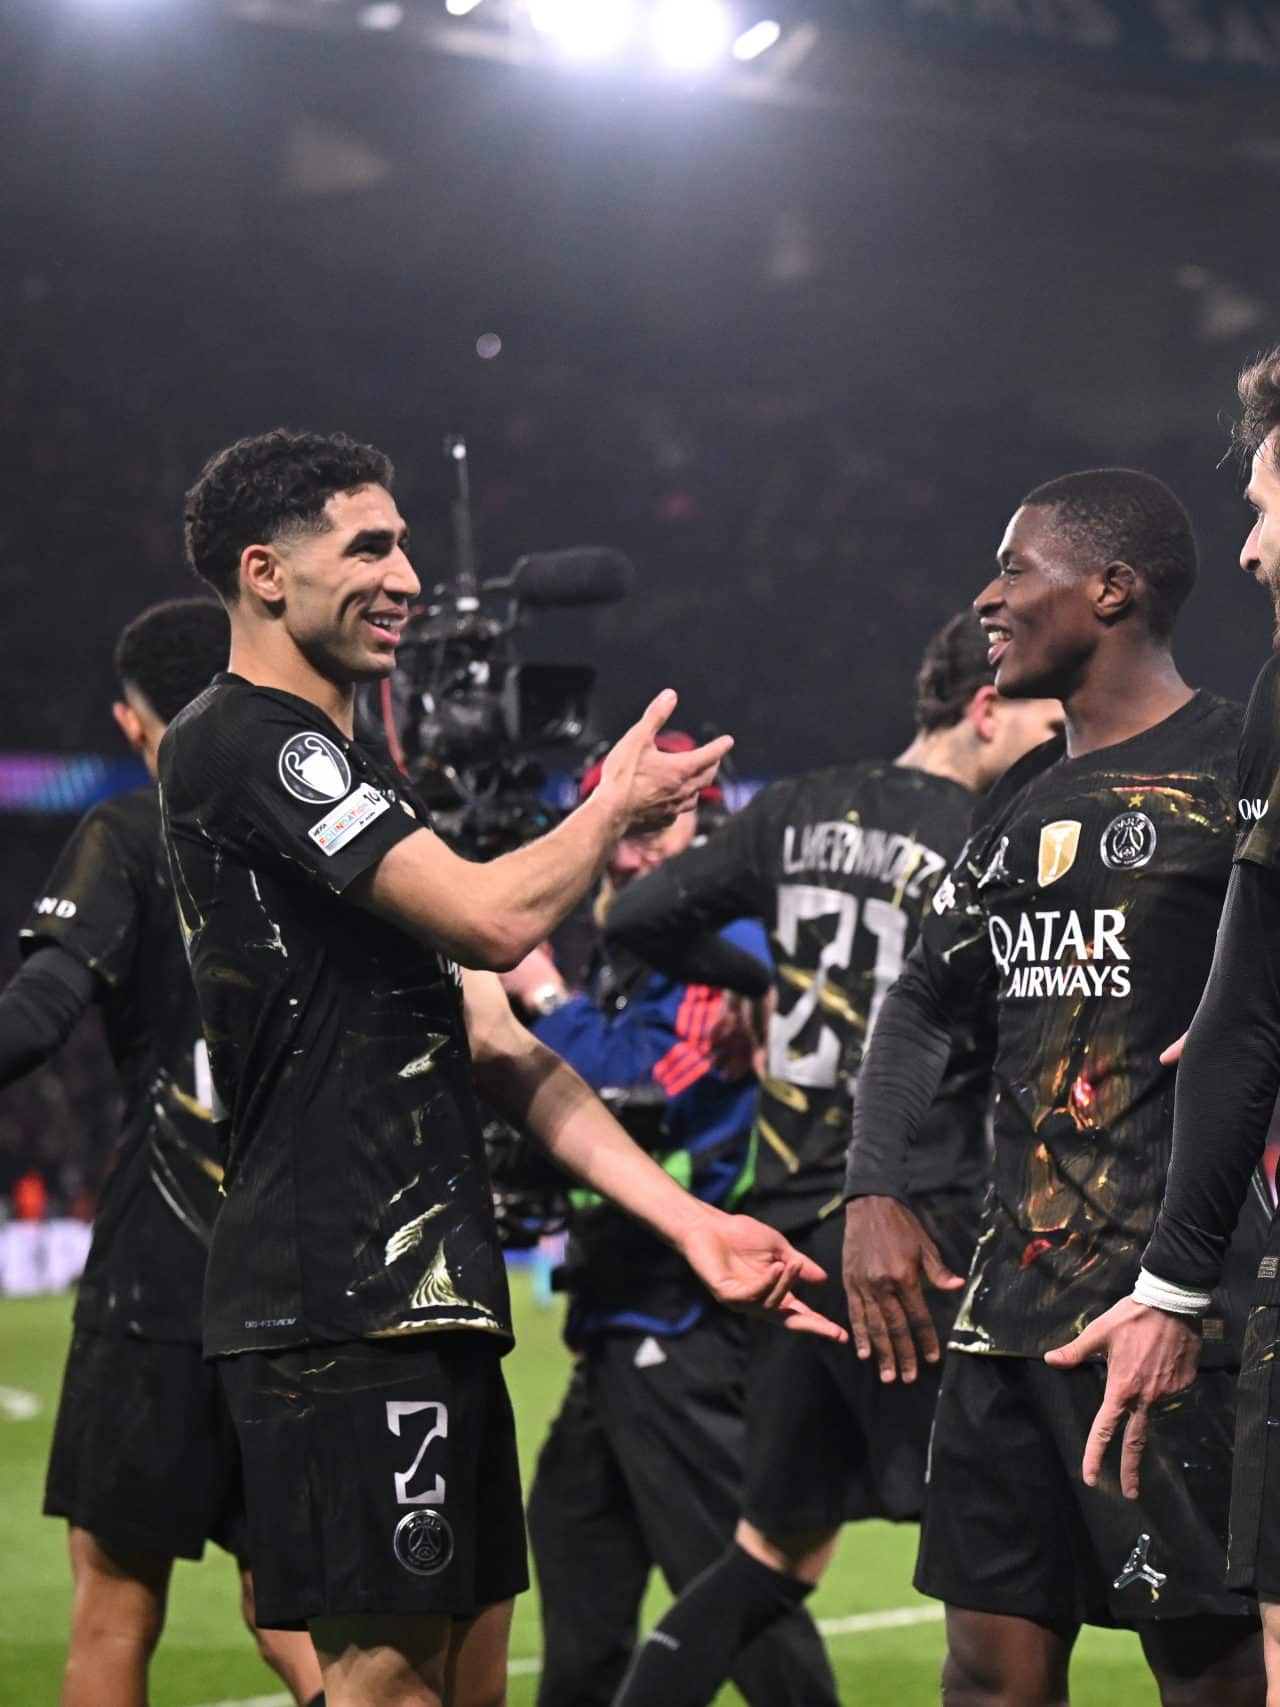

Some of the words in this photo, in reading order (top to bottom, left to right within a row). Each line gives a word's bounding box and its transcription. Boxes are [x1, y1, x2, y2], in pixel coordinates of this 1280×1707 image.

[34, 897, 77, 919] ND
[988, 908, 1131, 976] QATAR
[1006, 965, 1132, 998] AIRWAYS
